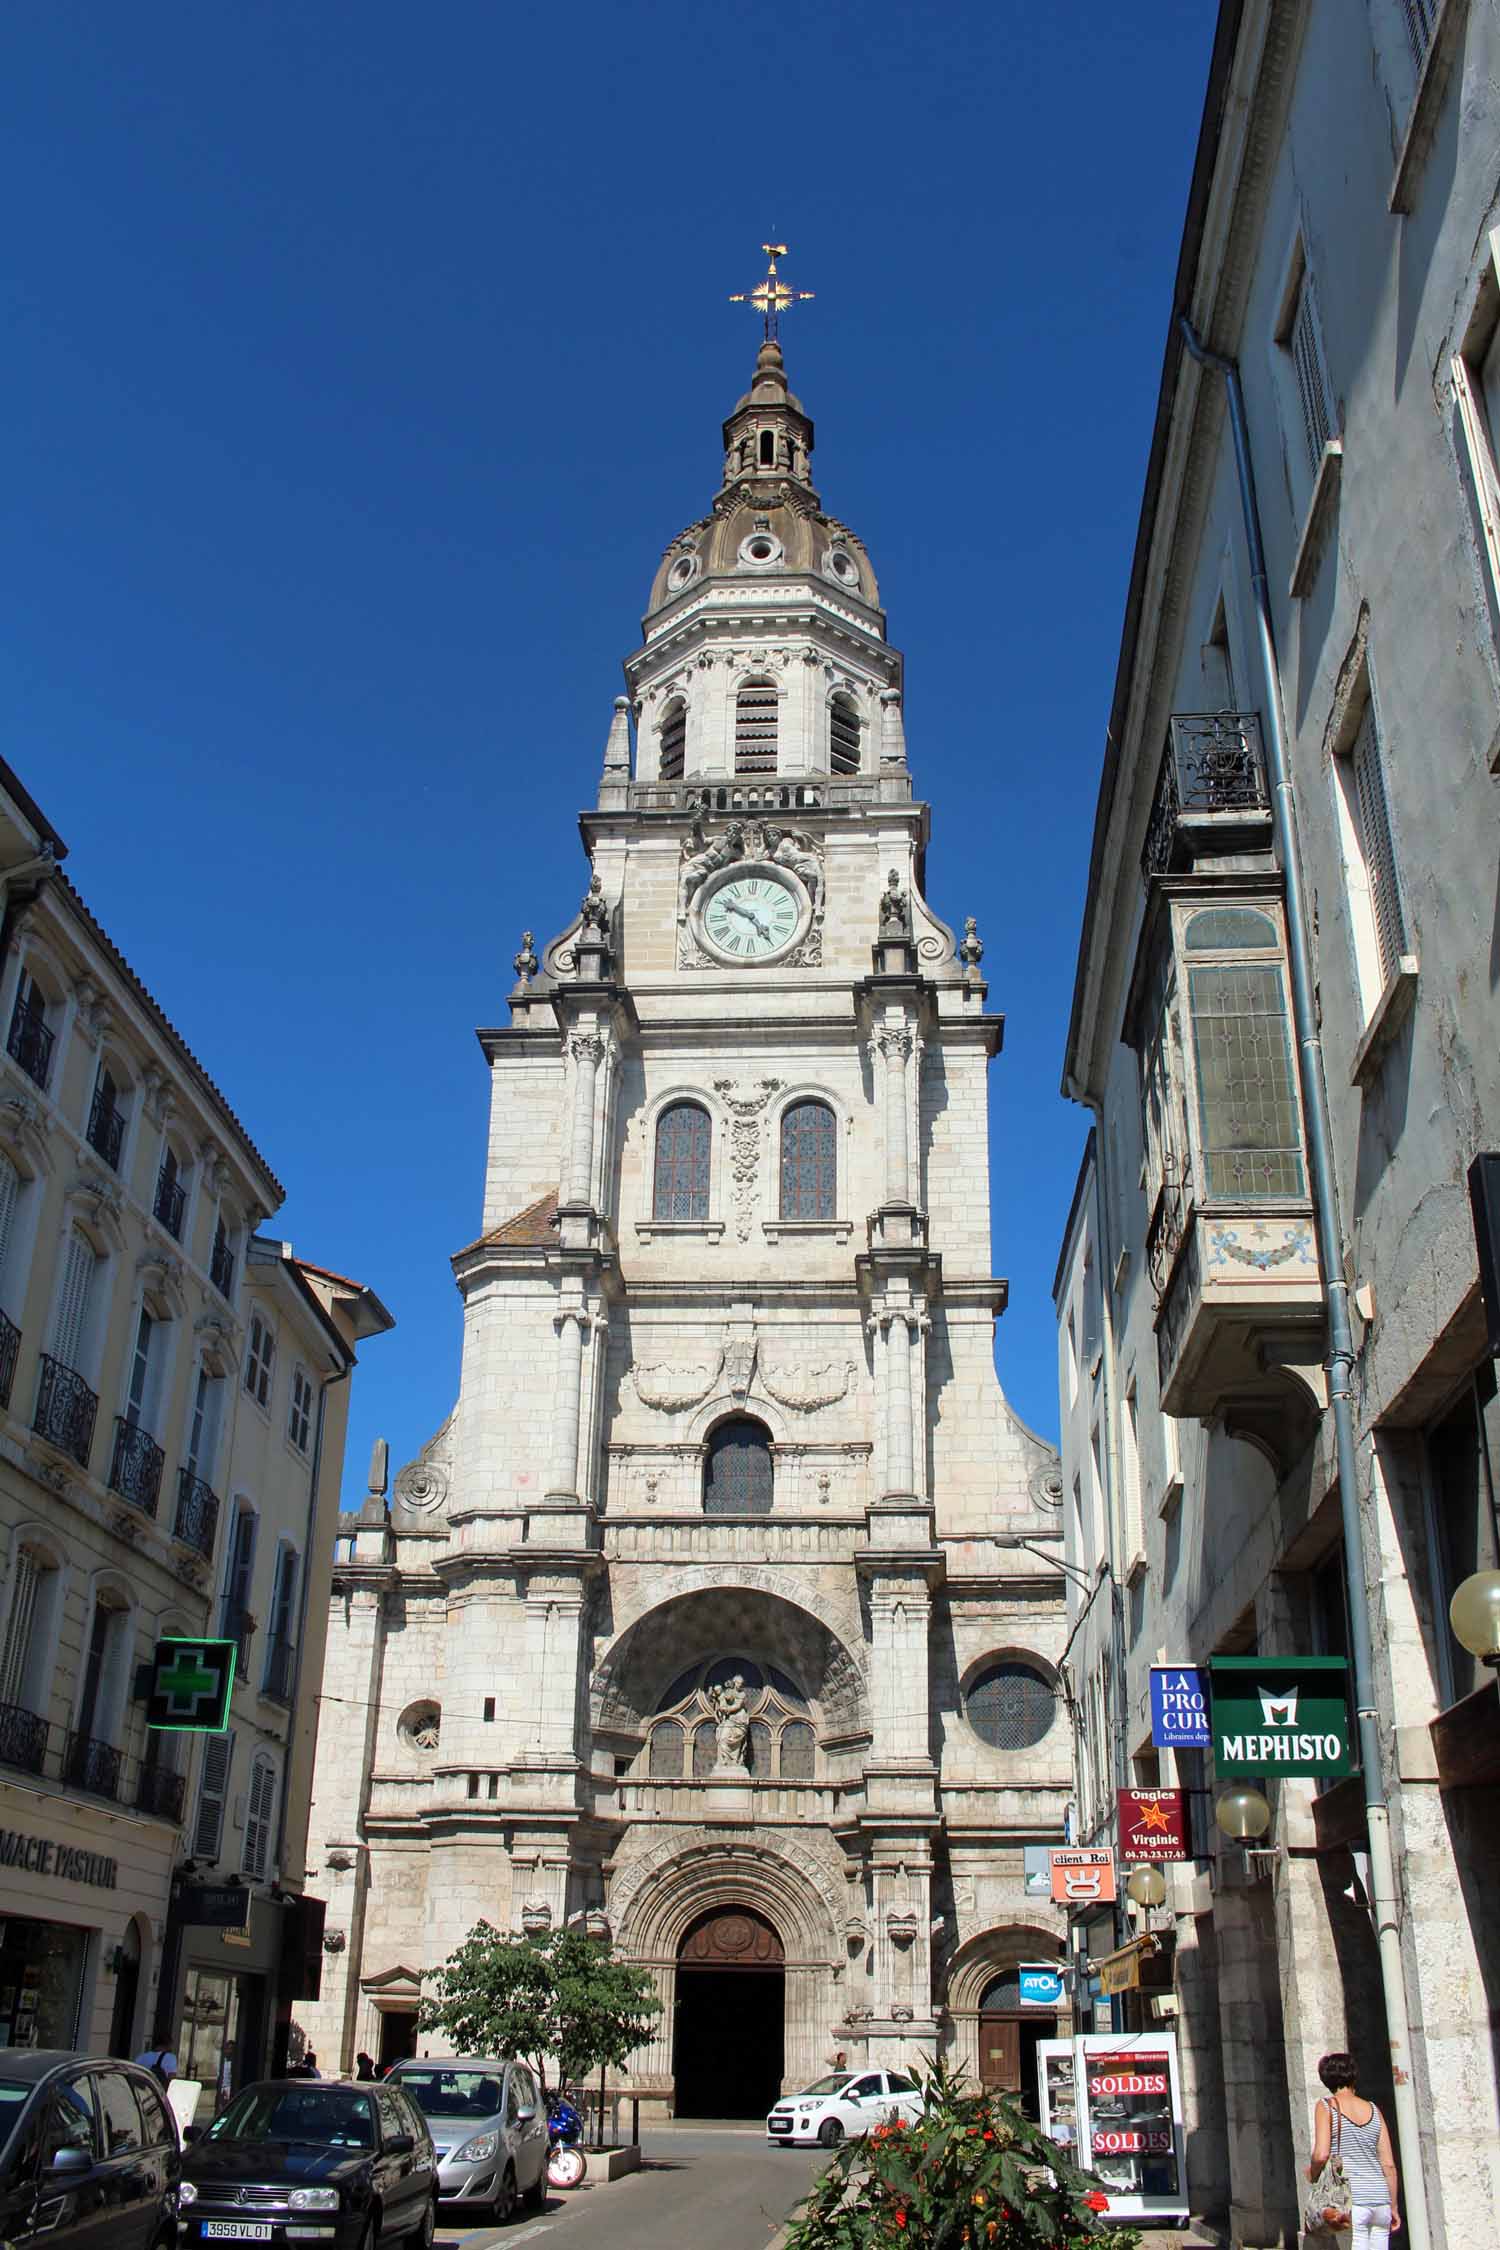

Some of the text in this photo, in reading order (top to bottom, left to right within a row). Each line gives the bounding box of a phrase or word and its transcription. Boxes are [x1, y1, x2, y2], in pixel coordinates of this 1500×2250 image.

[1161, 1673, 1190, 1691] LA
[1162, 1692, 1204, 1711] PRO
[1221, 1733, 1341, 1761] MEPHISTO
[1131, 1790, 1176, 1802] Ongles
[1131, 1834, 1180, 1848] Virginie
[1055, 1852, 1110, 1865] client Roi
[1024, 1976, 1059, 1990] ATOL
[1091, 2075, 1165, 2094] SOLDES
[1095, 2131, 1169, 2150] SOLDES
[209, 2223, 268, 2238] 3959 VL 01
